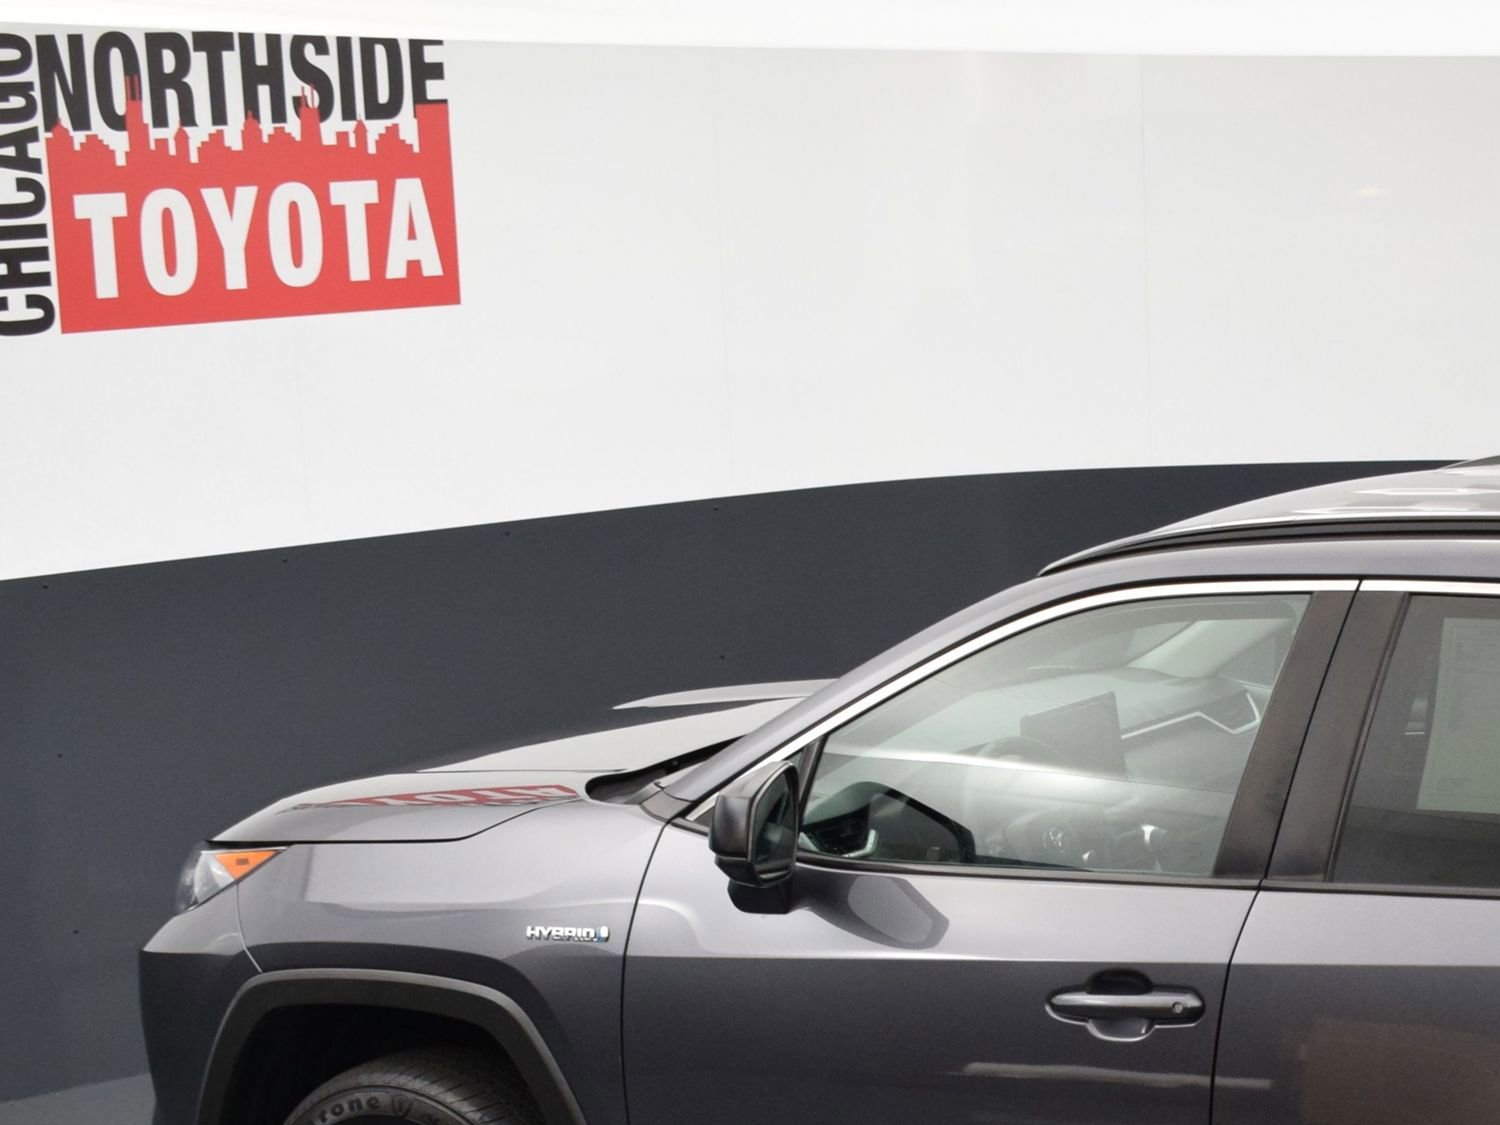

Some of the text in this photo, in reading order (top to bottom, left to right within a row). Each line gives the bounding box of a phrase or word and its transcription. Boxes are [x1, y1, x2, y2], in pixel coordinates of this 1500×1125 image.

[36, 30, 449, 133] NORTHSIDE
[0, 33, 56, 337] CHICAGO
[73, 177, 444, 300] TOYOTA
[526, 925, 596, 941] HYBRID
